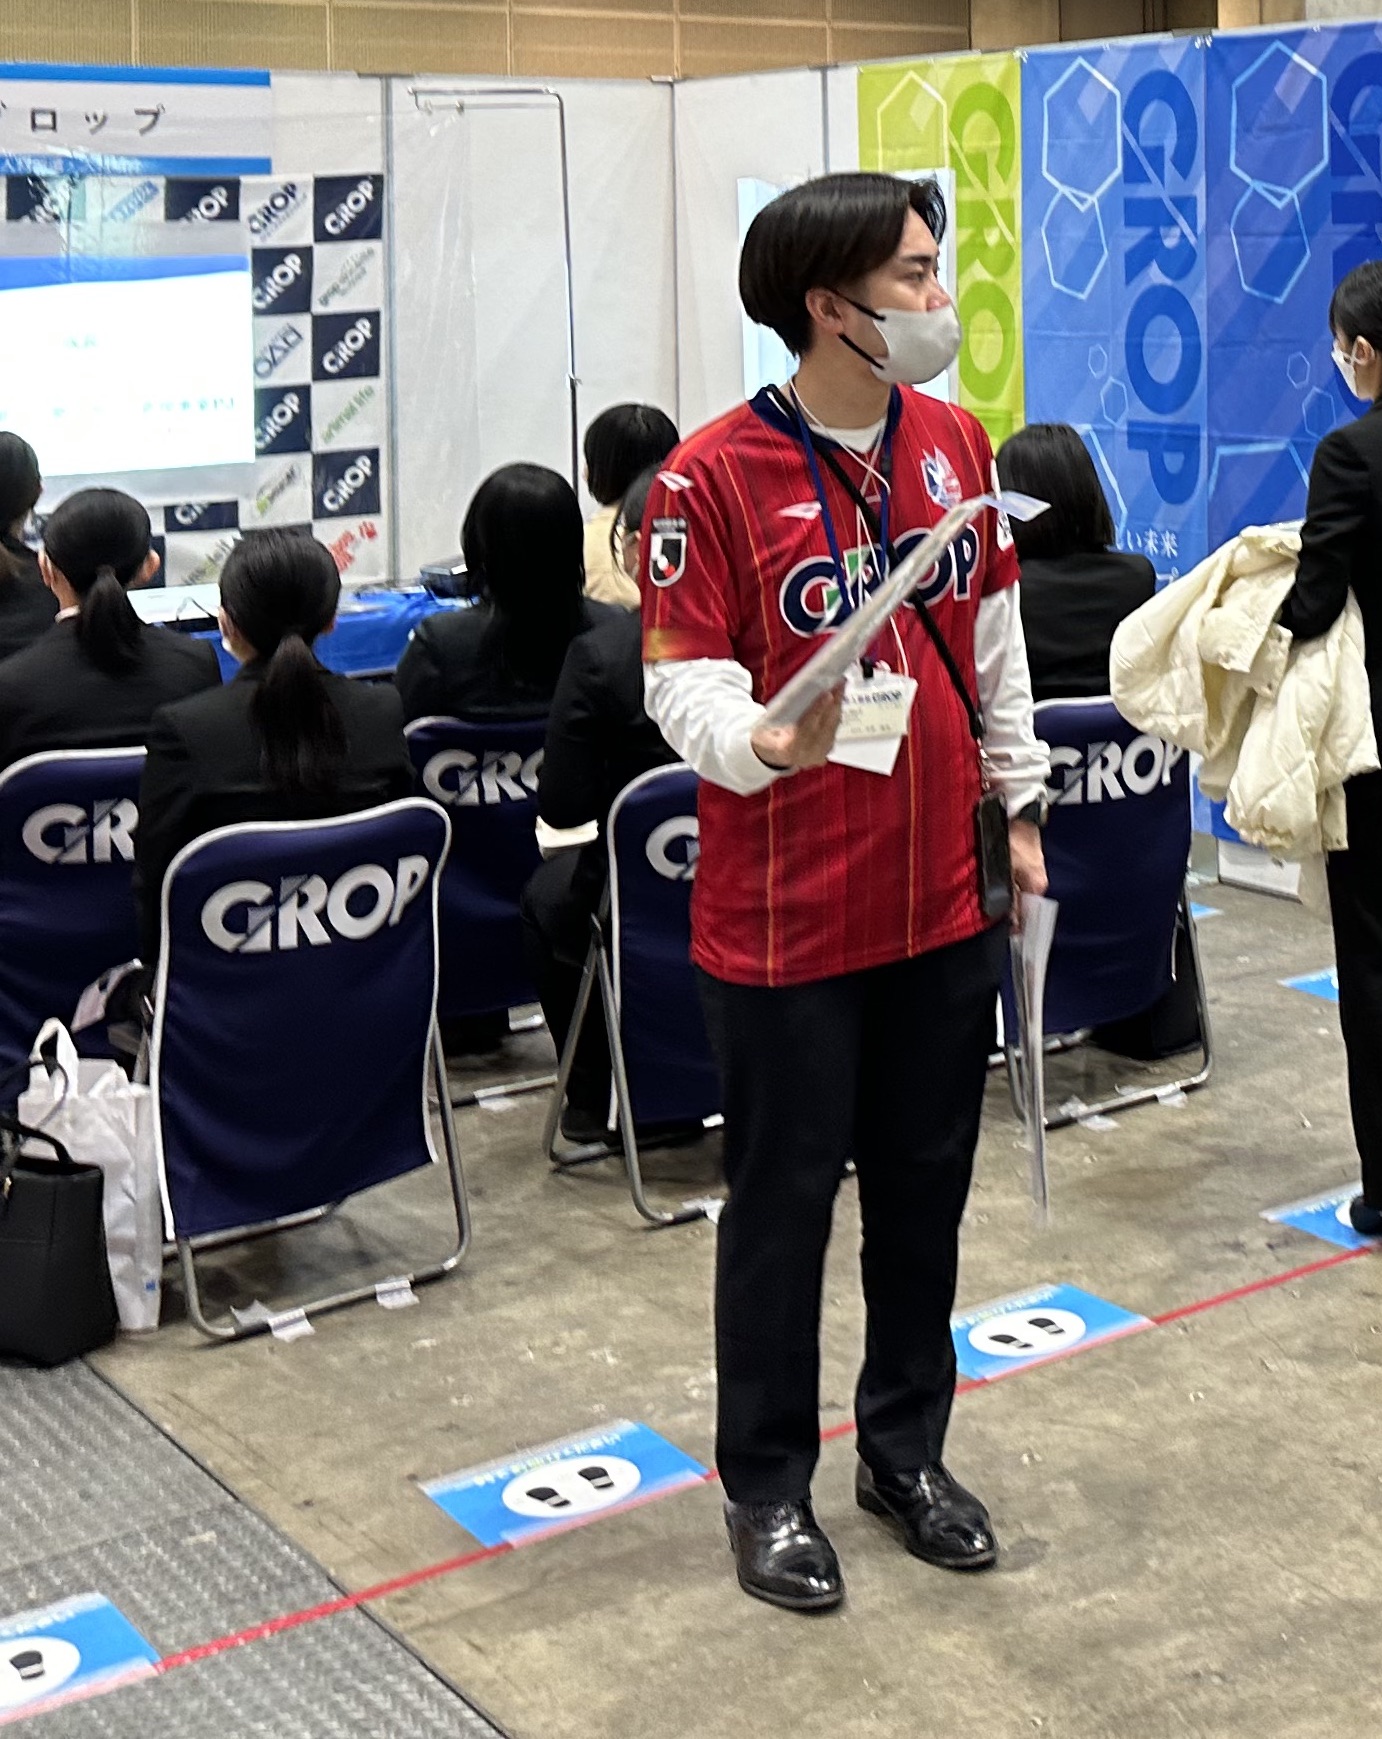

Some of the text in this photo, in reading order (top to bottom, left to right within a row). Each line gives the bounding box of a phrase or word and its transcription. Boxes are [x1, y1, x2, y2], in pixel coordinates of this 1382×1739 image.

[0, 100, 165, 136] ロップ
[1122, 69, 1201, 504] GROP
[201, 855, 430, 955] GROP
